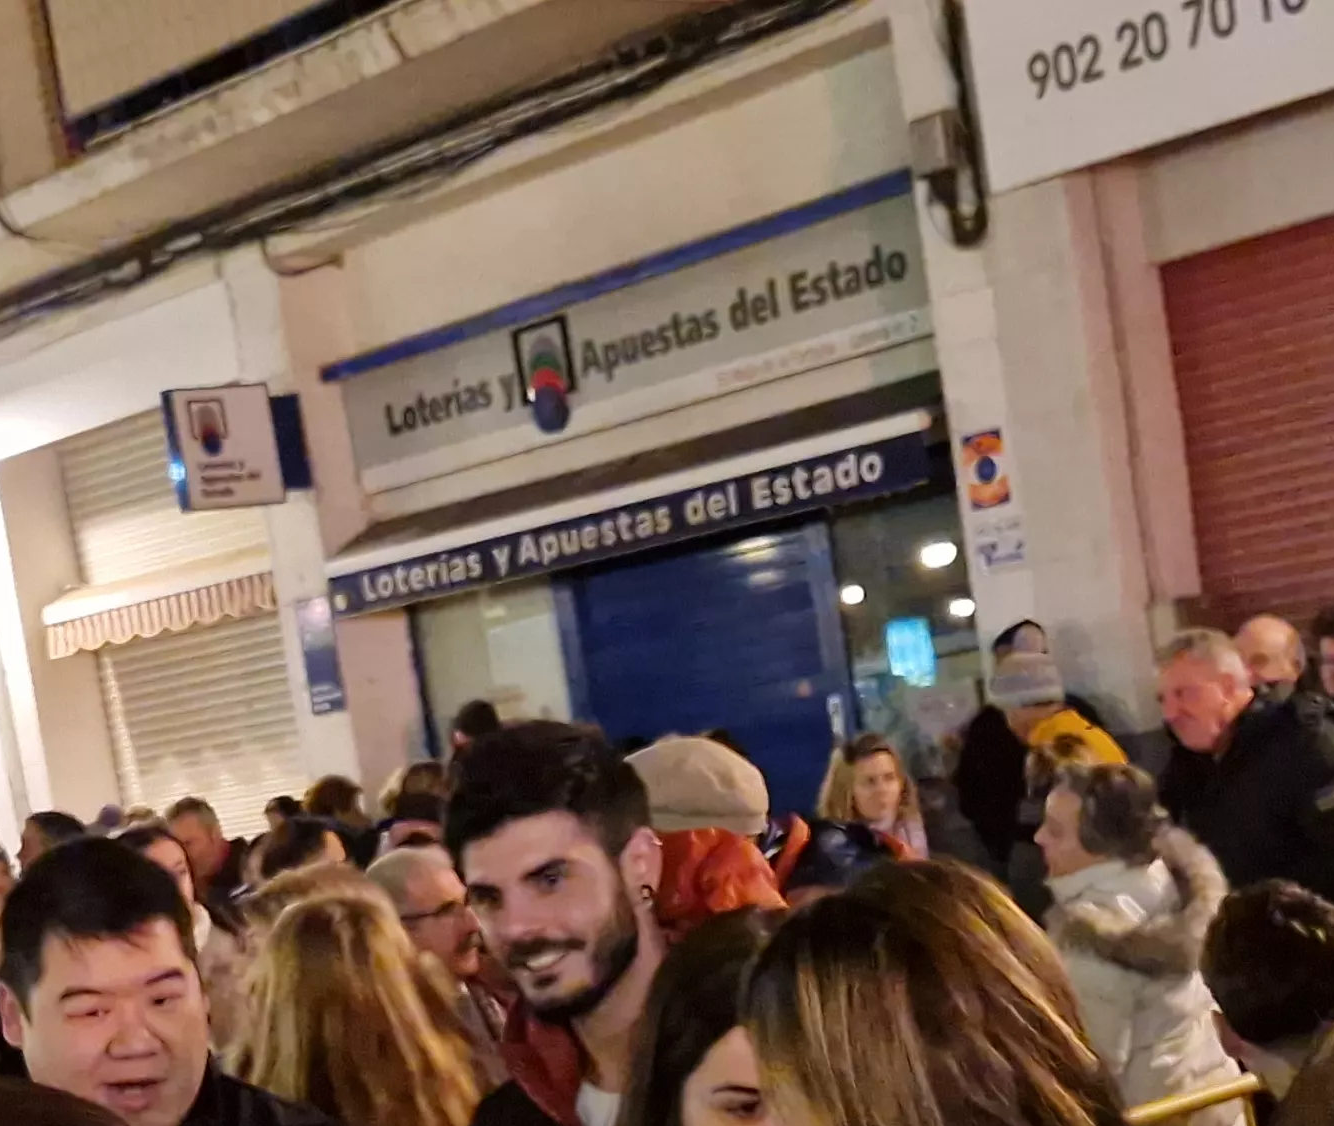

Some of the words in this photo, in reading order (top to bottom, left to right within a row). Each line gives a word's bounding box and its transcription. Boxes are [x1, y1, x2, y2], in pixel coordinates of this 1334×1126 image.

[1026, 33, 1105, 100] 902
[1116, 10, 1168, 72] 20
[1180, 0, 1236, 49] 70
[384, 376, 493, 437] Loterías
[497, 373, 516, 413] y
[580, 308, 720, 382] Apuestas
[728, 278, 781, 332] del
[788, 243, 908, 314] Estado
[361, 550, 484, 602] Loterías
[491, 543, 511, 578] y
[517, 503, 672, 567] Apuestas
[683, 480, 739, 526] del
[750, 450, 885, 510] Estado
